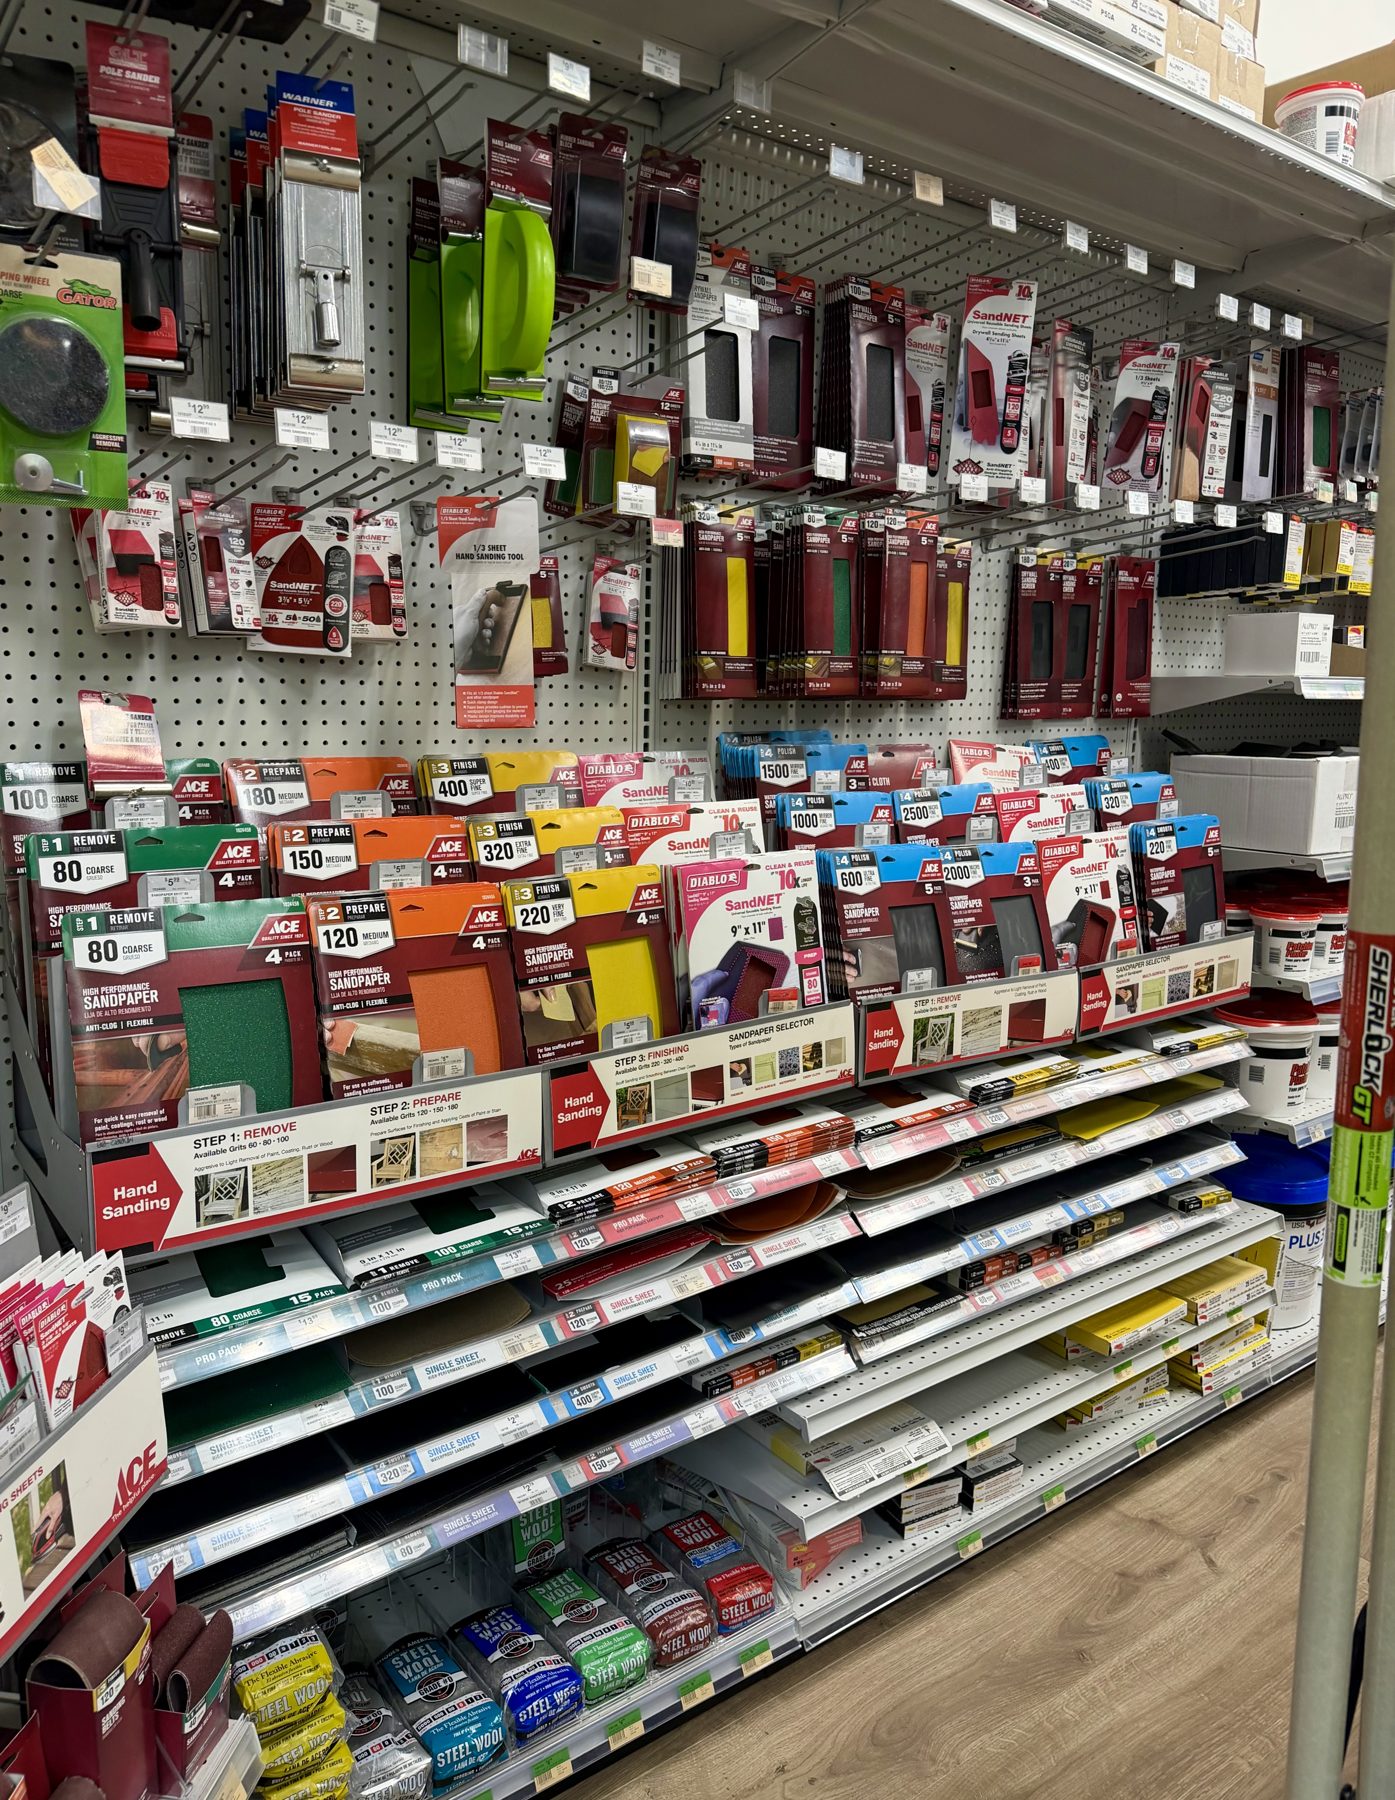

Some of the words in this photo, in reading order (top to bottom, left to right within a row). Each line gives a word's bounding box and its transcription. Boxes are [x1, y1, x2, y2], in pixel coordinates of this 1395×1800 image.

[1100, 8, 1116, 22] P50A
[1131, 23, 1138, 35] 25
[100, 65, 123, 77] POLE
[125, 69, 160, 85] SANDER
[293, 106, 314, 115] POLE
[316, 109, 341, 119] SANDER
[505, 141, 521, 152] SANDER
[610, 145, 624, 154] ACE
[736, 262, 748, 272] ACE
[730, 277, 740, 286] 15
[753, 276, 766, 286] 100
[800, 290, 812, 300] ACE
[850, 284, 864, 296] 100
[852, 303, 872, 314] DRYWALL
[891, 298, 903, 308] ACE
[852, 310, 878, 323] SANDPAPER
[888, 314, 894, 324] 5
[972, 310, 1030, 323] SandNET
[906, 338, 946, 354] SandNET
[1132, 361, 1168, 370] SandNET
[1212, 393, 1232, 404] 220
[1150, 436, 1159, 444] 80
[698, 511, 710, 521] 320
[807, 514, 816, 524] 80
[886, 516, 897, 526] 120
[228, 536, 246, 548] 120
[698, 532, 724, 543] SANDPAPER
[473, 544, 485, 552] 1/3
[488, 544, 506, 552] SHEET
[476, 553, 505, 561] SANDING
[507, 553, 524, 561] TOOL
[269, 580, 316, 591] SandNET
[263, 766, 301, 776] PREPARE
[453, 760, 478, 770] FINISH
[587, 766, 622, 774] DIABLO
[762, 764, 790, 779] 1500
[438, 778, 468, 798] 400
[10, 788, 48, 810] 100
[51, 794, 80, 803] COARSE
[244, 787, 275, 806] 180
[278, 792, 304, 800] MEDIUM
[1104, 795, 1120, 809] 320
[903, 805, 928, 820] 2500
[631, 816, 670, 827] DIABLO
[792, 812, 818, 828] 1000
[311, 827, 350, 838] PREPARE
[498, 822, 523, 832] FINISH
[73, 834, 116, 846] REMOVE
[484, 842, 513, 862] 320
[1149, 840, 1165, 854] 220
[289, 850, 322, 870] 150
[325, 854, 352, 864] MEDIUM
[851, 855, 870, 863] POLISH
[53, 860, 82, 882] 80
[86, 864, 115, 874] COARSE
[943, 864, 970, 881] 2000
[1070, 863, 1107, 875] SandNET
[1150, 869, 1176, 881] SANDPAPER
[690, 875, 727, 888] DIABLO
[841, 871, 862, 887] 600
[346, 903, 386, 914] PREPARE
[725, 894, 781, 912] SandNET
[109, 912, 155, 925] REMOVE
[520, 906, 550, 926] 220
[844, 907, 879, 919] SANDPAPER
[322, 927, 357, 949] 120
[362, 931, 389, 940] MEDIUM
[88, 939, 118, 963] 80
[122, 944, 153, 953] COARSE
[265, 949, 282, 964] 4
[285, 950, 301, 958] PACK
[525, 949, 574, 967] SANDPAPER
[343, 966, 383, 976] PERFORMANCE
[330, 973, 391, 991] SANDPAPER
[82, 988, 99, 996] HIGH
[101, 982, 150, 994] PERFORMANCE
[1086, 990, 1103, 1001] Hand
[84, 990, 159, 1010] SANDPAPER
[1083, 998, 1107, 1011] Sanding
[85, 1021, 118, 1033] ANTI-CLOG
[126, 1018, 154, 1028] FLEXIBLE
[1362, 944, 1391, 1096] SHERLOCK
[729, 1026, 775, 1043] SANDPAPER
[776, 1017, 814, 1034] SELECTOR
[873, 1028, 893, 1038] Hand
[868, 1038, 899, 1051] Sanding
[370, 1103, 398, 1116] STEP
[401, 1102, 410, 1110] 2:
[413, 1092, 461, 1108] PREPARE
[564, 1093, 594, 1109] Hand
[1351, 1083, 1373, 1125] GT
[557, 1105, 603, 1124] Sanding
[193, 1134, 226, 1149] STEP
[230, 1133, 240, 1142] 1:
[244, 1122, 297, 1140] REMOVE
[226, 1158, 238, 1166] Light
[239, 1155, 259, 1163] Removal
[113, 1180, 158, 1201] Hand
[102, 1195, 171, 1221] Sanding
[1291, 1221, 1305, 1229] USG
[434, 1246, 456, 1256] 100
[459, 1239, 484, 1250] COARSE
[762, 1244, 783, 1254] SINGLE
[784, 1238, 801, 1249] SHEET
[729, 1260, 742, 1271] 150
[289, 1292, 312, 1305] 15
[315, 1288, 336, 1300] PACK
[610, 1296, 634, 1310] SINGLE
[636, 1289, 656, 1302] SHEET
[210, 1314, 230, 1327] 80
[232, 1308, 262, 1322] COARSE
[424, 1361, 451, 1375] SINGLE
[452, 1351, 480, 1366] SHEET
[209, 1440, 243, 1455] SINGLE
[244, 1425, 274, 1442] SHEET
[380, 1467, 400, 1482] 320
[10, 1465, 44, 1503] SHEETS
[612, 1552, 652, 1575] WOOL
[535, 1573, 573, 1595] STEEL
[542, 1581, 584, 1603] WOOL
[392, 1646, 437, 1669] STEEL
[246, 1678, 258, 1687] The
[259, 1666, 288, 1682] Flexible
[290, 1651, 318, 1666] Abrasive
[397, 1656, 444, 1680] WOOL
[100, 1688, 114, 1707] 120
[250, 1700, 292, 1726] STEEL
[294, 1677, 328, 1701] WOOL
[436, 1742, 472, 1768] STEEL
[474, 1724, 504, 1749] WOOL
